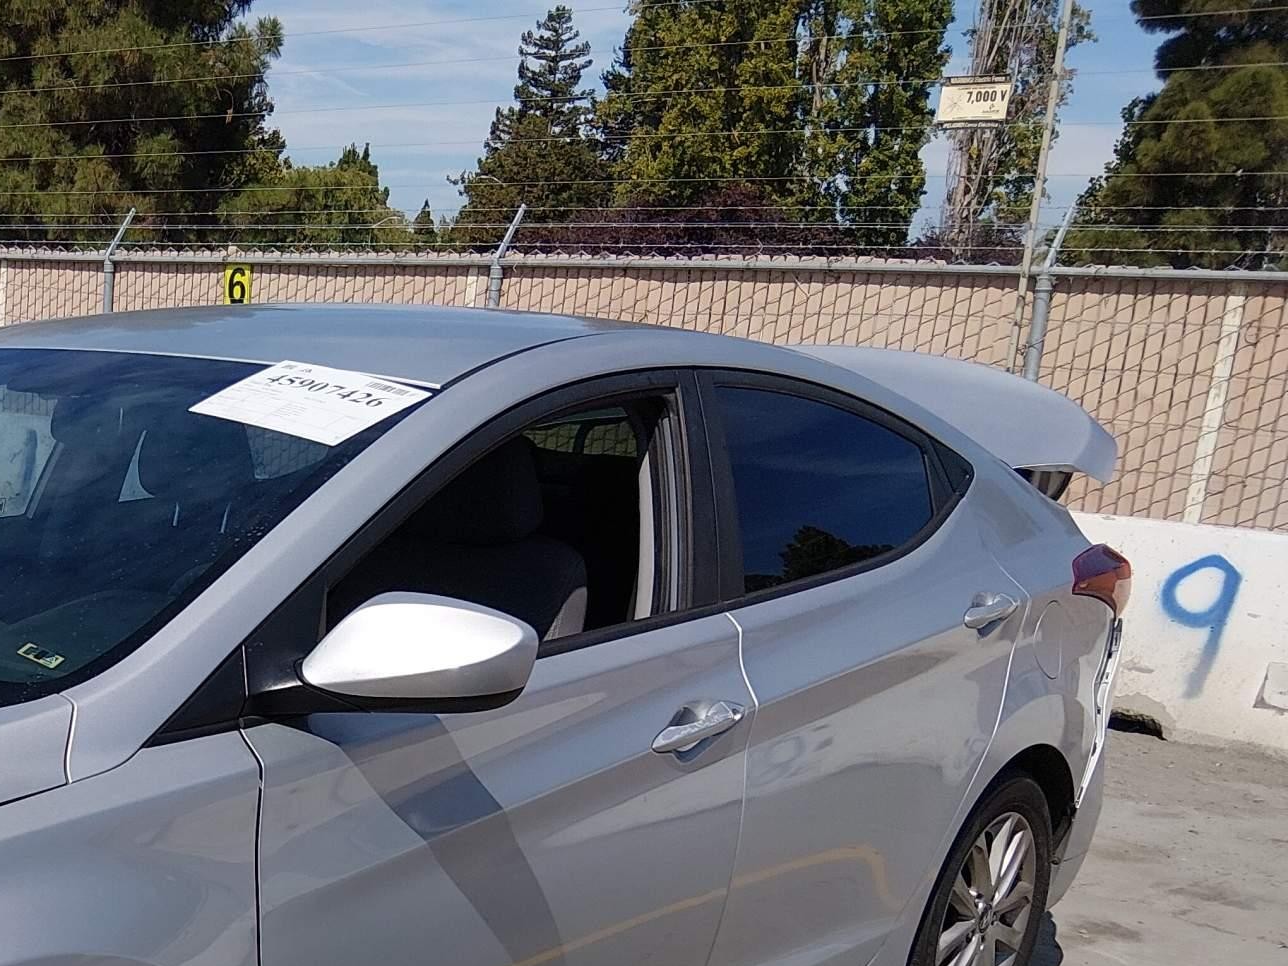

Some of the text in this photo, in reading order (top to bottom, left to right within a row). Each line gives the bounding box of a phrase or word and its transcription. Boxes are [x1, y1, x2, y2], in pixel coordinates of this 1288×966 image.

[966, 89, 1008, 104] 7,000 V
[228, 267, 246, 304] 6
[266, 374, 384, 409] 45907426
[1160, 554, 1243, 698] 9
